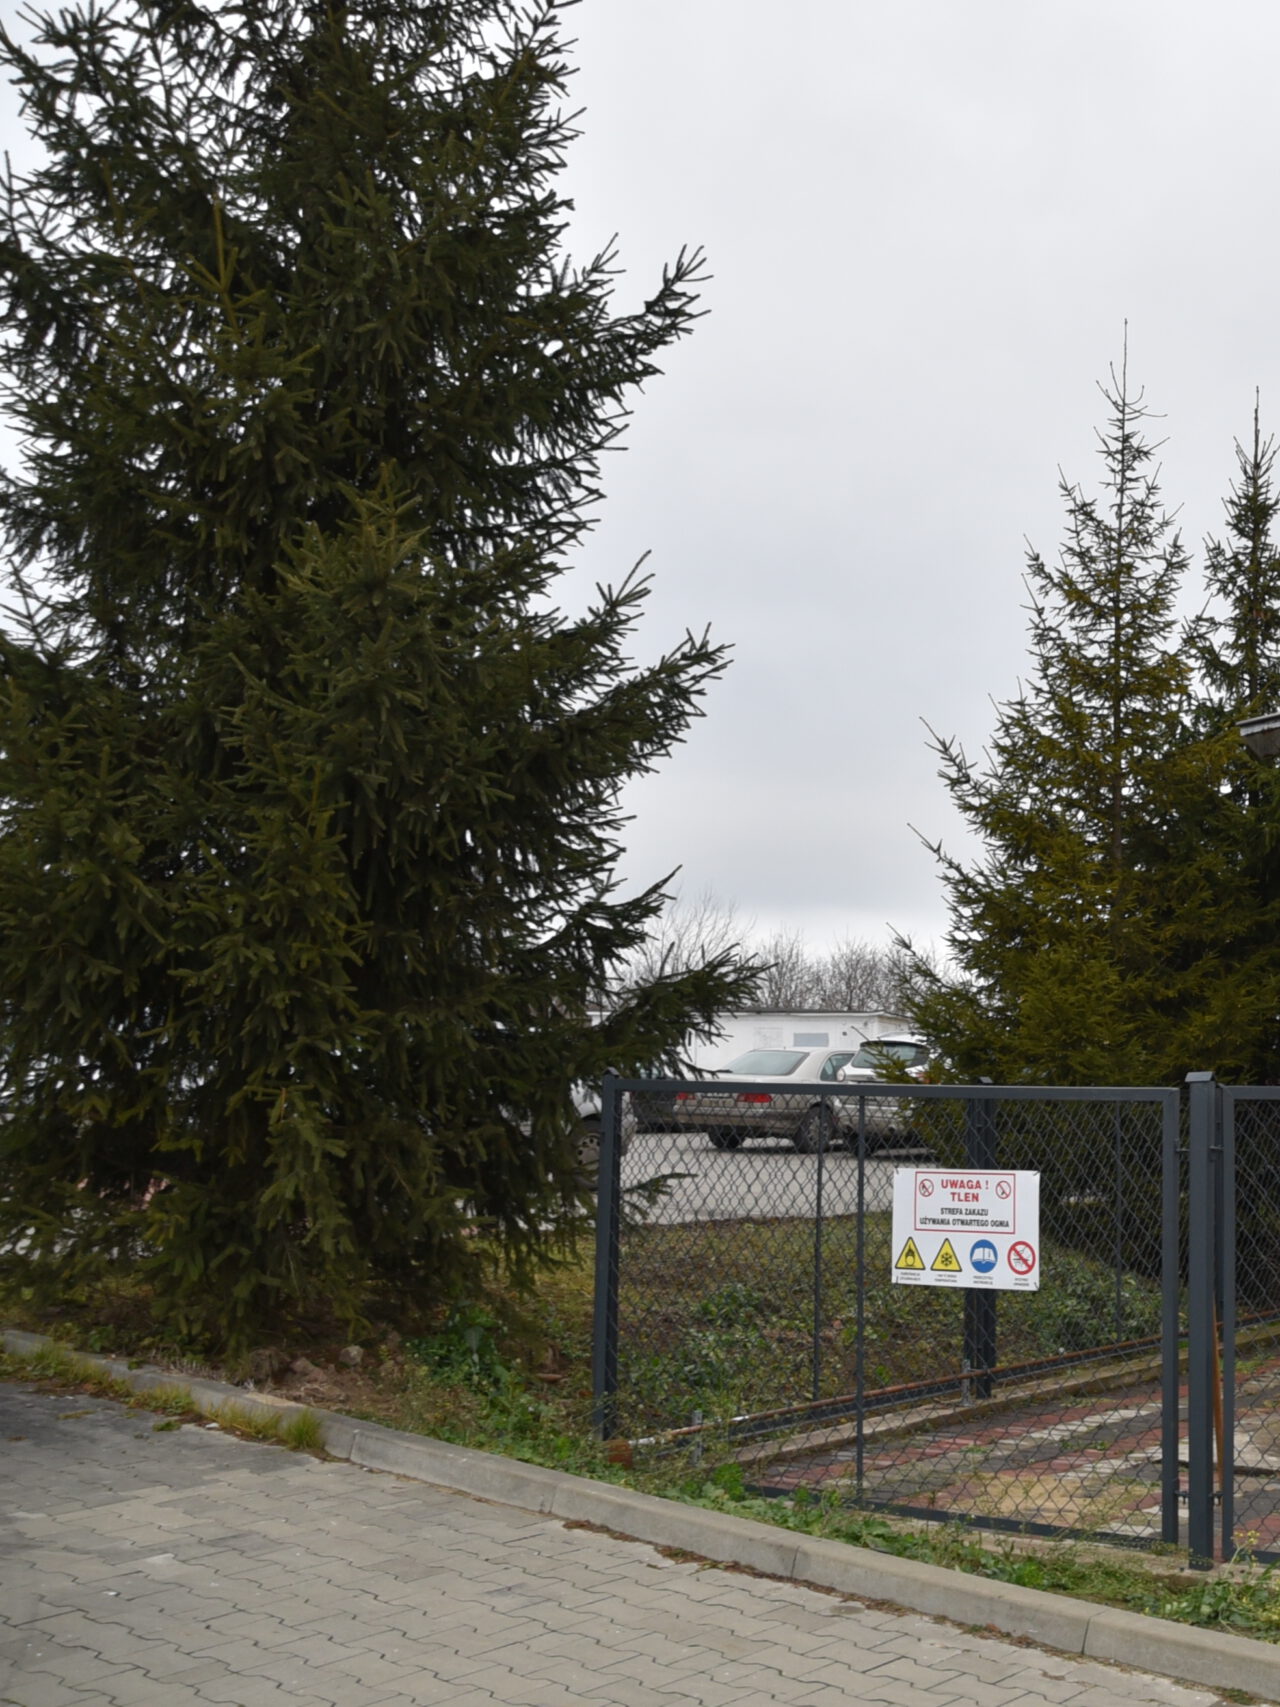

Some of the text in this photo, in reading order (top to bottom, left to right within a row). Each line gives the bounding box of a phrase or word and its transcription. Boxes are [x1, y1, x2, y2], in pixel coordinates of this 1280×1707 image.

[940, 1179, 982, 1190] UWAGA
[950, 1191, 979, 1202] TLEN
[940, 1207, 989, 1216] STREFA ZAKAZU
[919, 1216, 951, 1225] UŻYWANIA
[952, 1218, 989, 1227] OTWARTEGO
